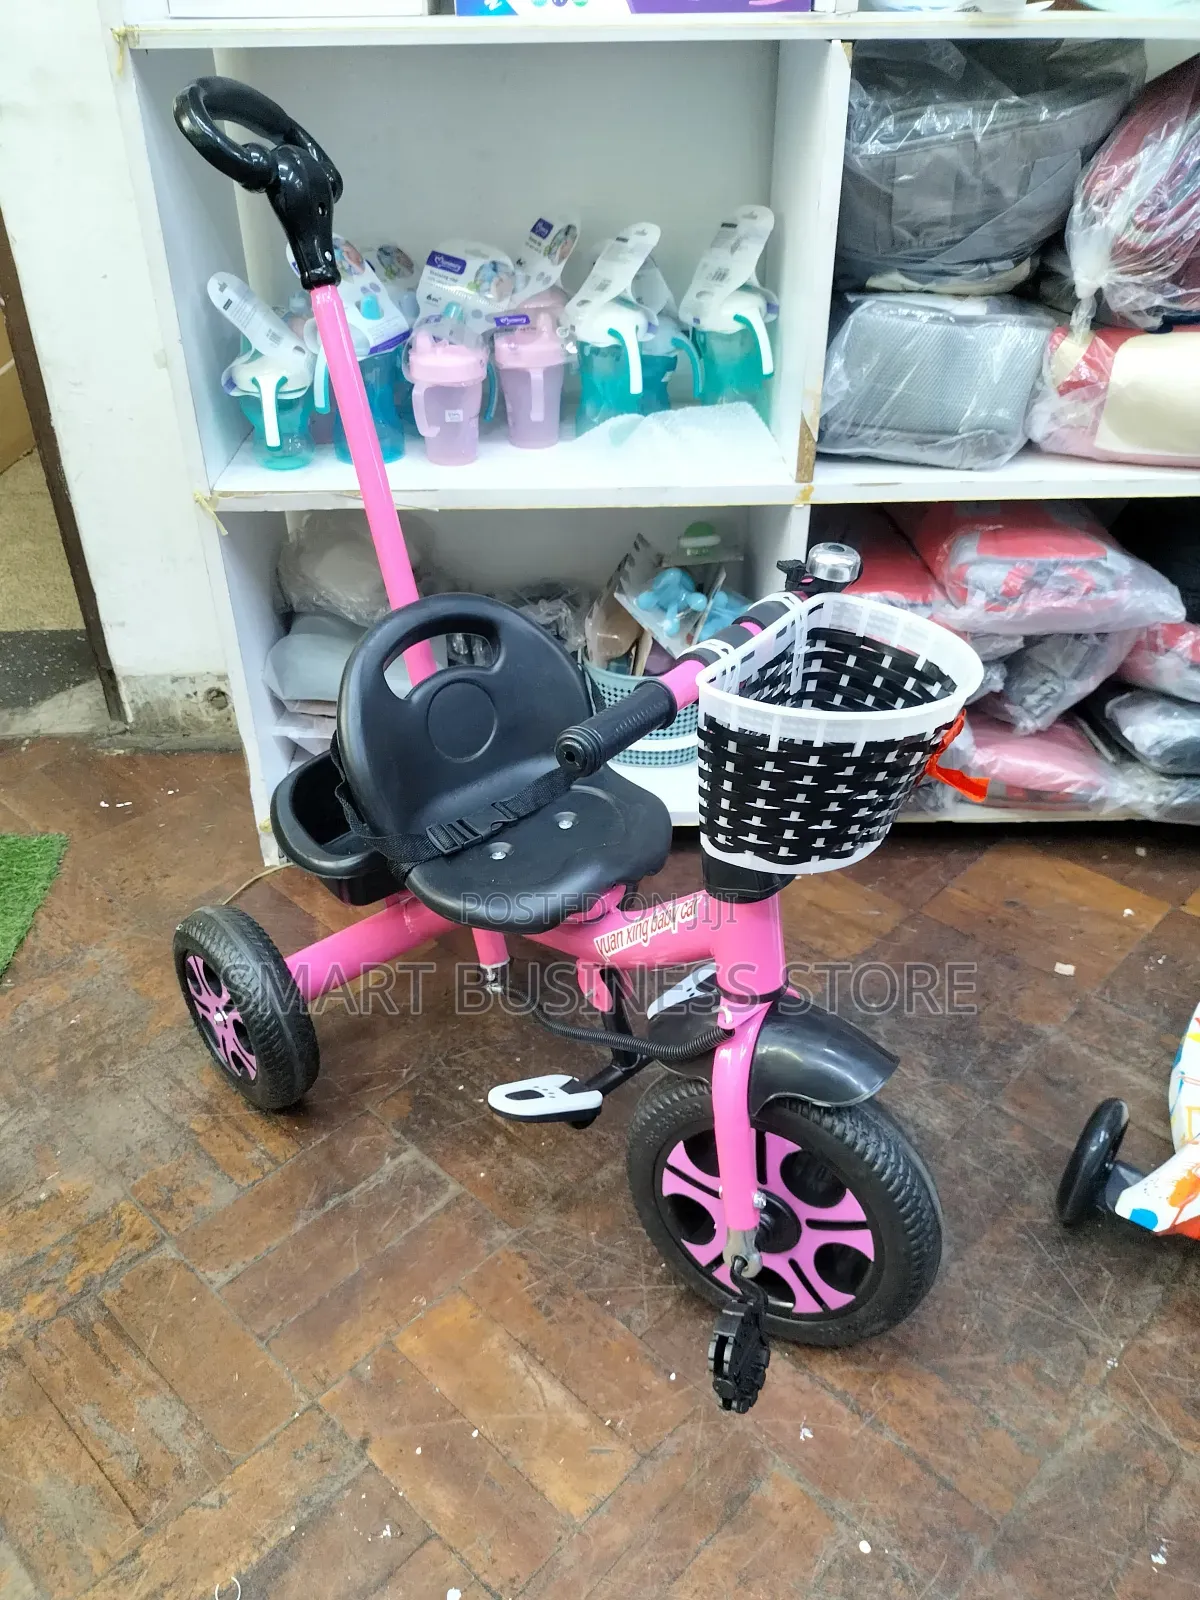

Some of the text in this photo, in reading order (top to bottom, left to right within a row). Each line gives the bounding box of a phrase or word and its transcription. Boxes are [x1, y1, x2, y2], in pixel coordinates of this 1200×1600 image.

[626, 918, 649, 944] xing
[650, 903, 679, 931] baby
[680, 897, 699, 920] car
